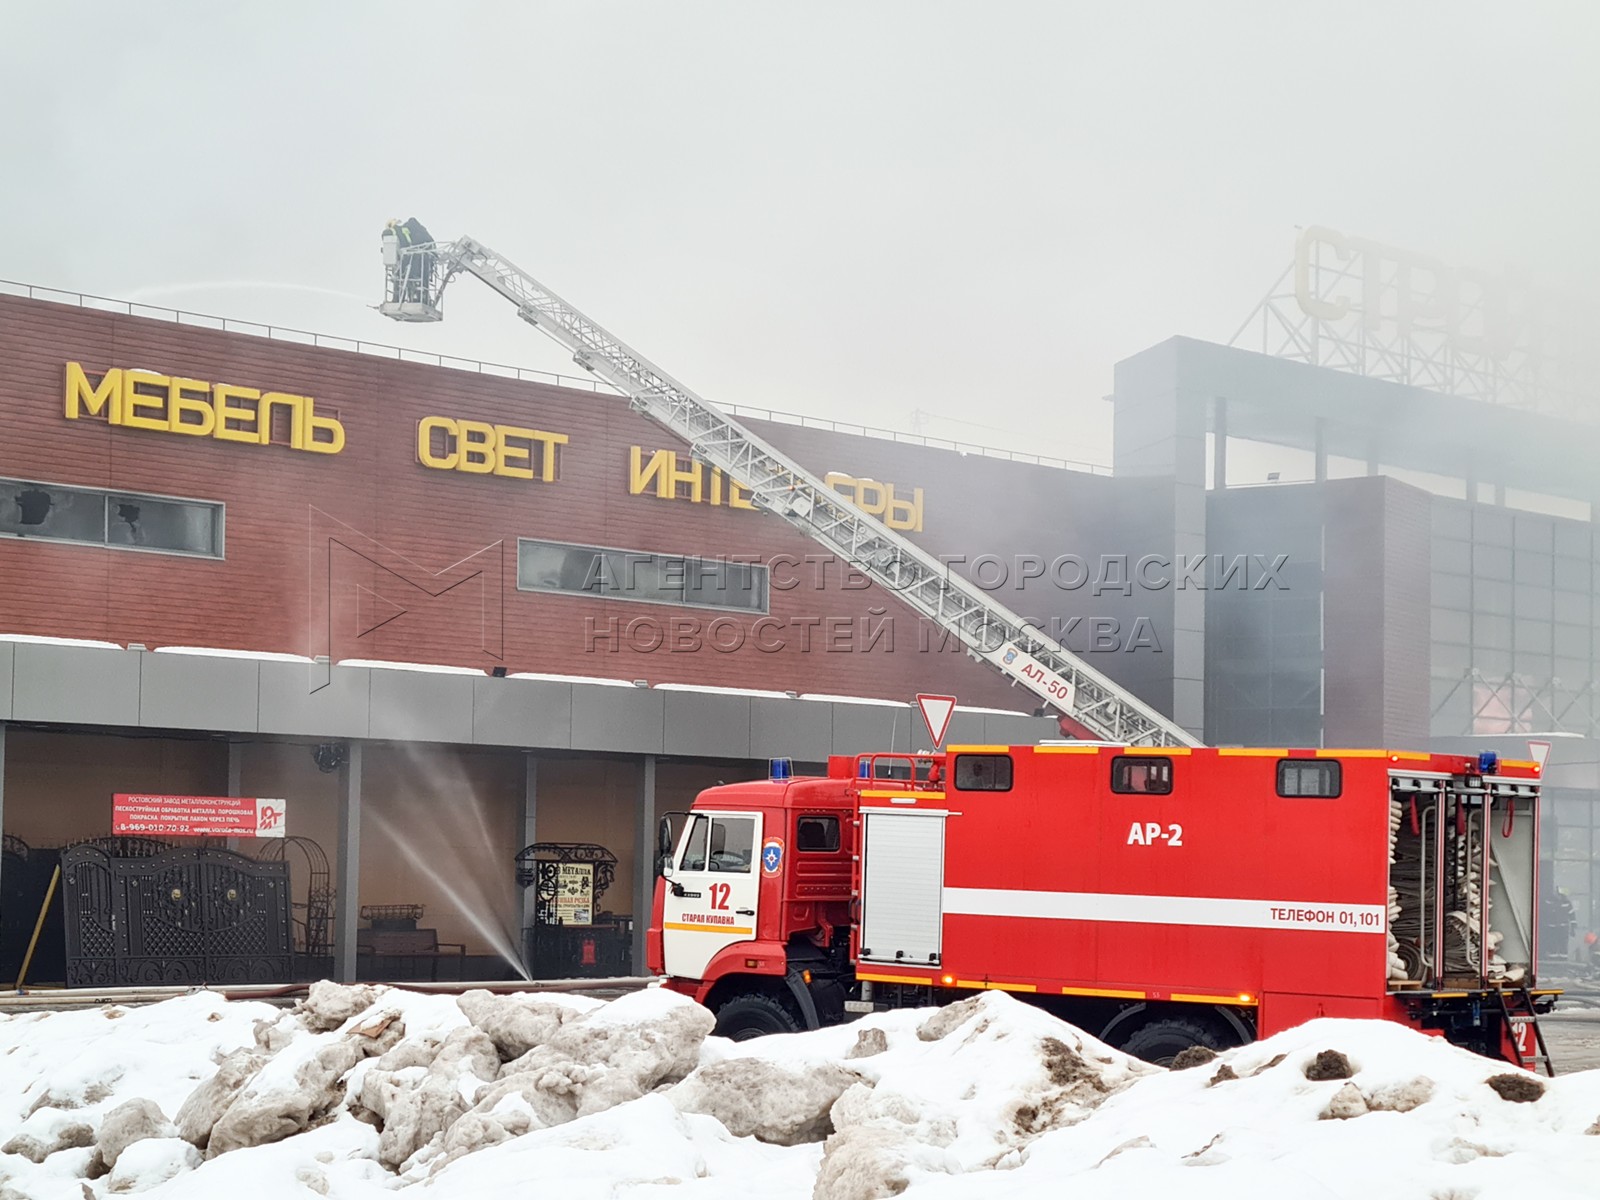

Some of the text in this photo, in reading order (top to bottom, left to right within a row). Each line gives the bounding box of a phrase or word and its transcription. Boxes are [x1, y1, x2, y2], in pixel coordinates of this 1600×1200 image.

[64, 361, 924, 532] МЕБЕЛЬ СВЕТ ИНТЕЕРЫ
[1021, 663, 1068, 699] АЛ-50
[115, 805, 160, 813] ПЕСКОСТРУЙНАЯ
[128, 796, 162, 804] РОСТОВСКИЙ
[1127, 822, 1183, 847] АР-2
[709, 883, 731, 910] 12
[681, 913, 735, 925] СТАРАЯ КУПАВНА
[1270, 907, 1335, 924] ТЕЛЕФОН
